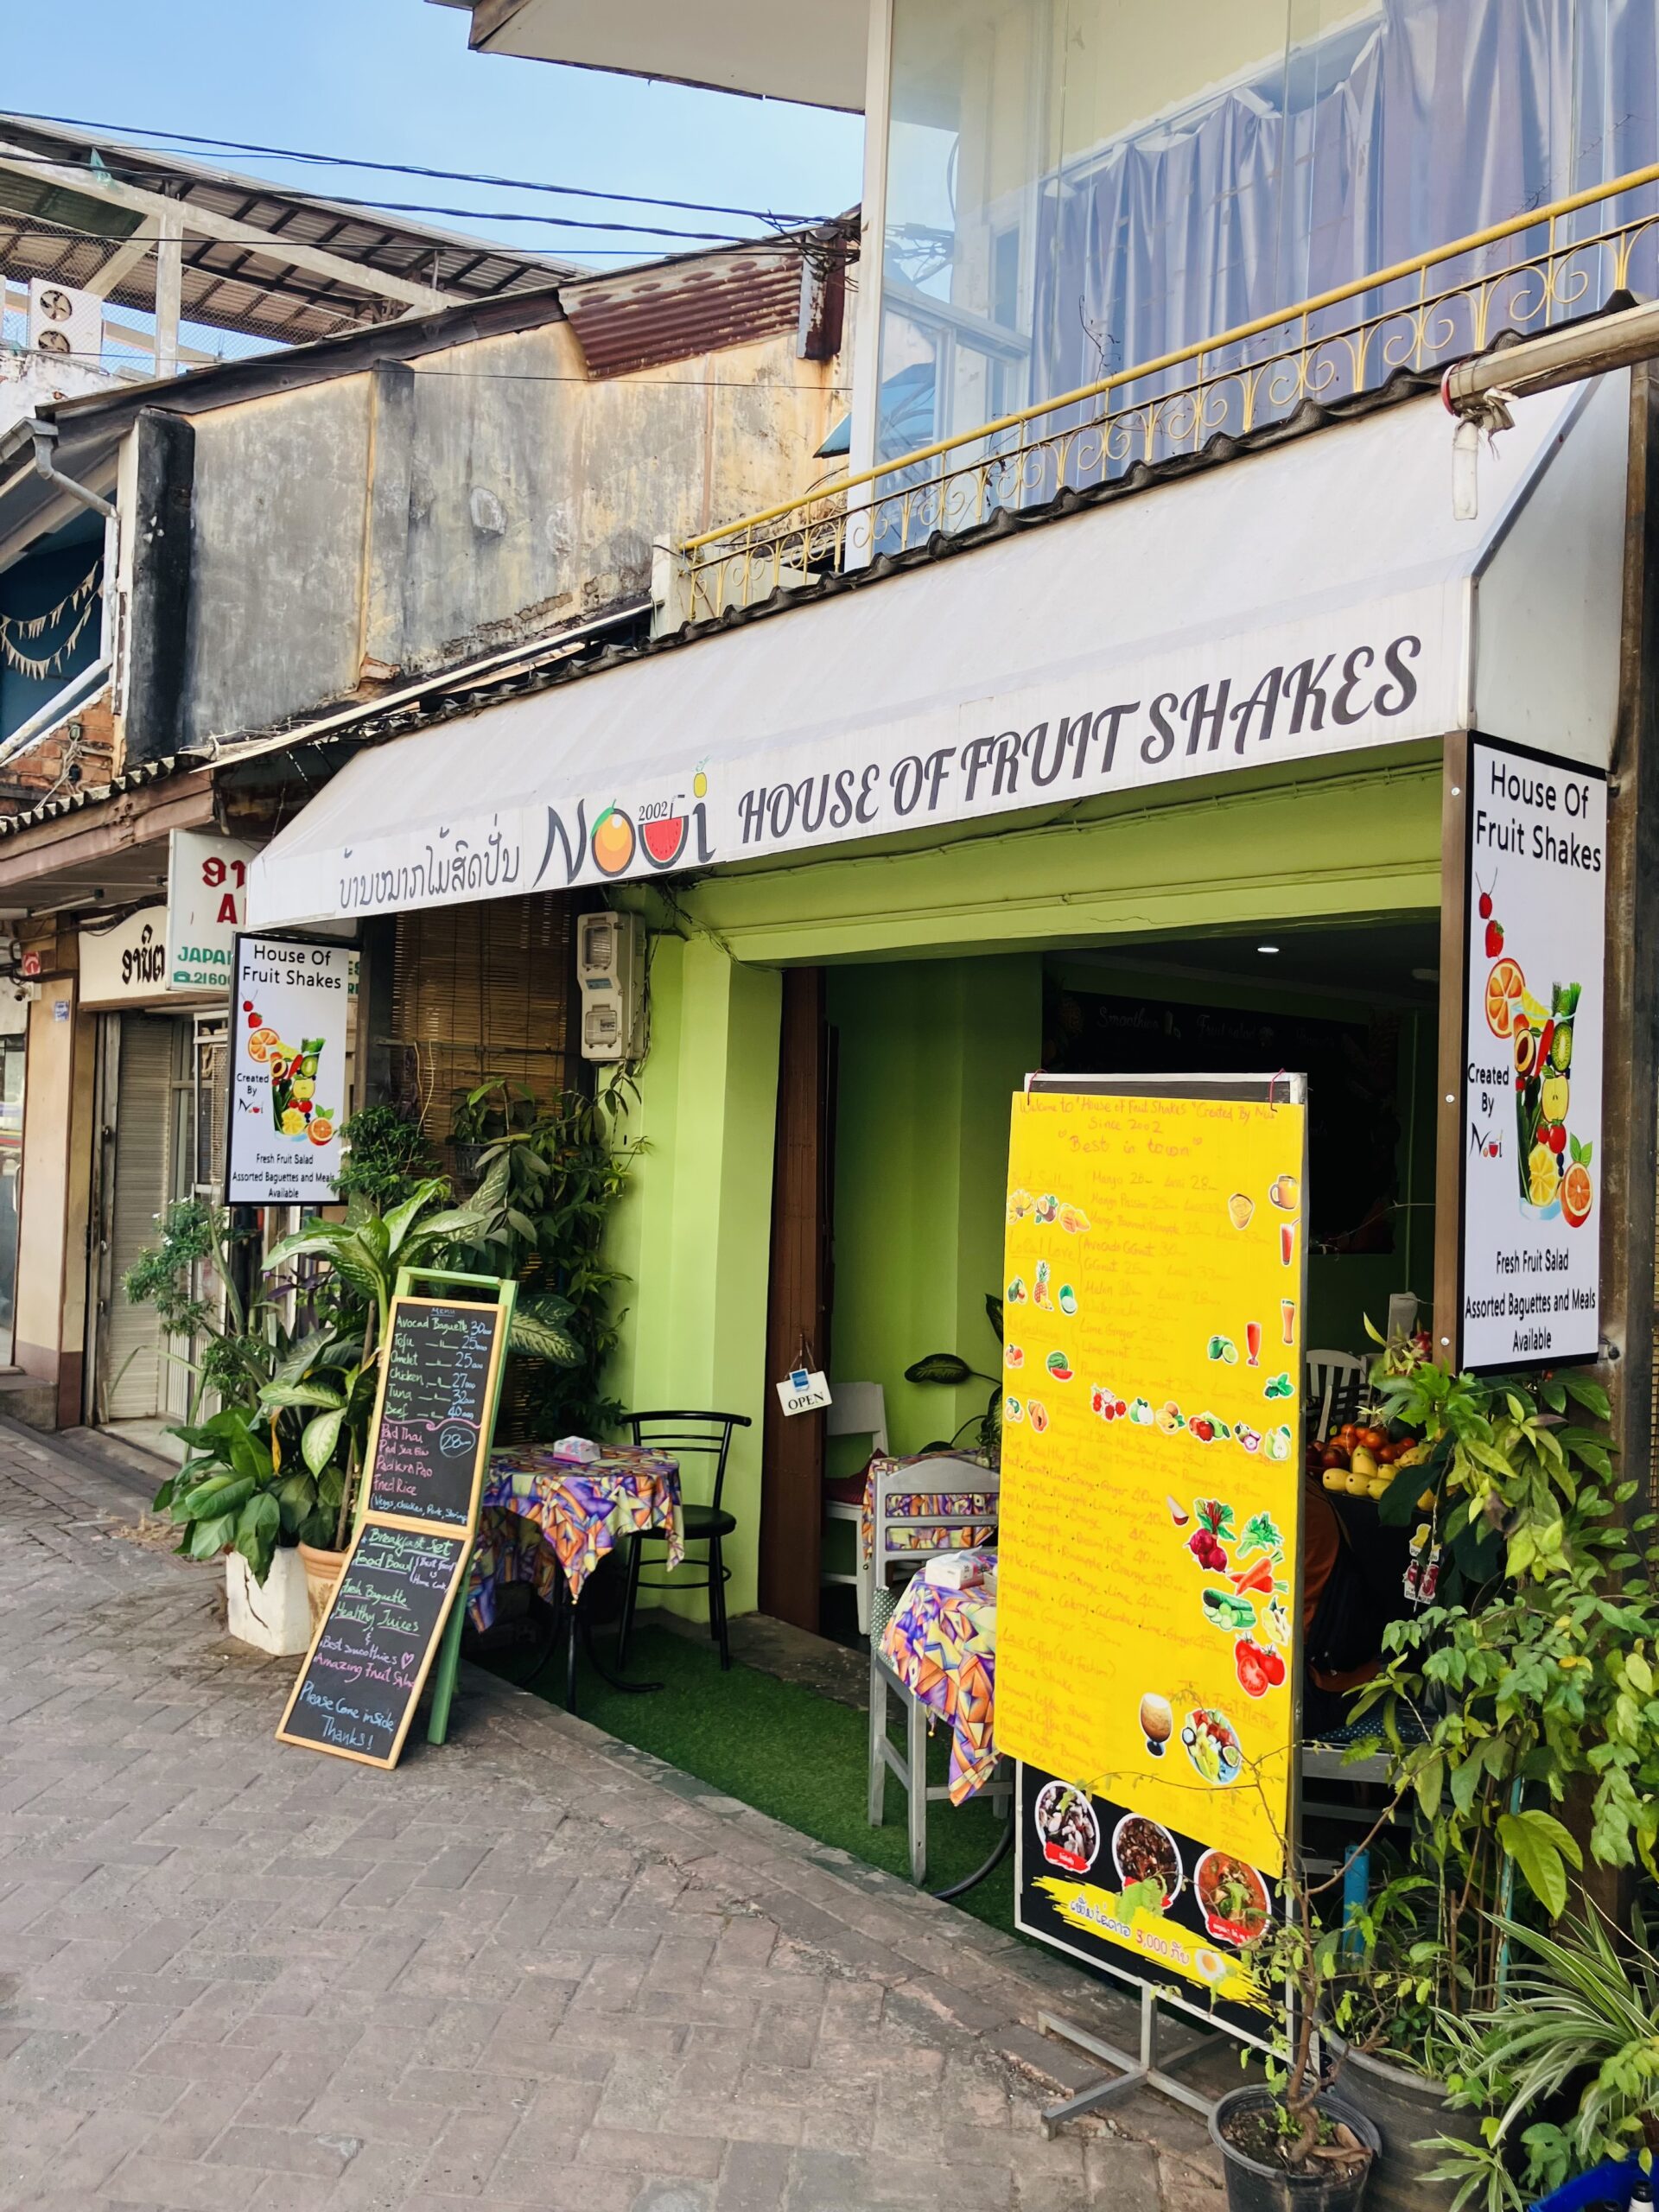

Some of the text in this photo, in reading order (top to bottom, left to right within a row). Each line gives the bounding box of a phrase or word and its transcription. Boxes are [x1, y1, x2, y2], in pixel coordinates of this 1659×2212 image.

[737, 634, 1422, 844] HOUSE OF FRUIT SHAKES
[1491, 760, 1589, 819] House Of
[638, 800, 668, 823] 2002
[1476, 810, 1602, 873] Fruit Shakes
[254, 944, 332, 966] House Of
[243, 967, 280, 984] Fruit
[286, 970, 341, 989] Shakes
[237, 1073, 269, 1084] Created
[1468, 1063, 1510, 1086] Created
[247, 1085, 257, 1096] By
[1060, 1096, 1074, 1113] to
[1238, 1105, 1251, 1127] By
[1481, 1091, 1495, 1118] By
[1088, 1116, 1163, 1134] Since 2002
[1123, 1140, 1135, 1154] in
[256, 1153, 314, 1165] Fresh Fruit Salad
[232, 1172, 264, 1182] Assorted
[265, 1172, 299, 1185] Baguettes
[301, 1173, 314, 1182] and
[268, 1188, 299, 1198] Available
[1497, 1248, 1569, 1274] Fresh Fruit Salad
[1465, 1287, 1596, 1321] Assorted Baguettes and Meals
[431, 1317, 468, 1336] Baguette
[394, 1333, 415, 1353] Tofu
[1512, 1325, 1551, 1353] Available
[390, 1351, 418, 1366] Omelet
[389, 1367, 424, 1386] Chicken
[388, 1383, 413, 1402] Tuna
[788, 1391, 824, 1410] OPEN
[385, 1401, 408, 1421] Beef
[397, 1478, 418, 1497] Rice
[369, 1528, 454, 1556] Breakfast Set
[365, 1585, 408, 1608] Baguette
[334, 1601, 420, 1632] Healthy Juices
[319, 1635, 397, 1665] Best Smoothies
[313, 1653, 363, 1683] Amazing
[365, 1662, 391, 1682] Fruit
[299, 1681, 395, 1732] Please Come inside
[1135, 1929, 1167, 1955] 3,000
